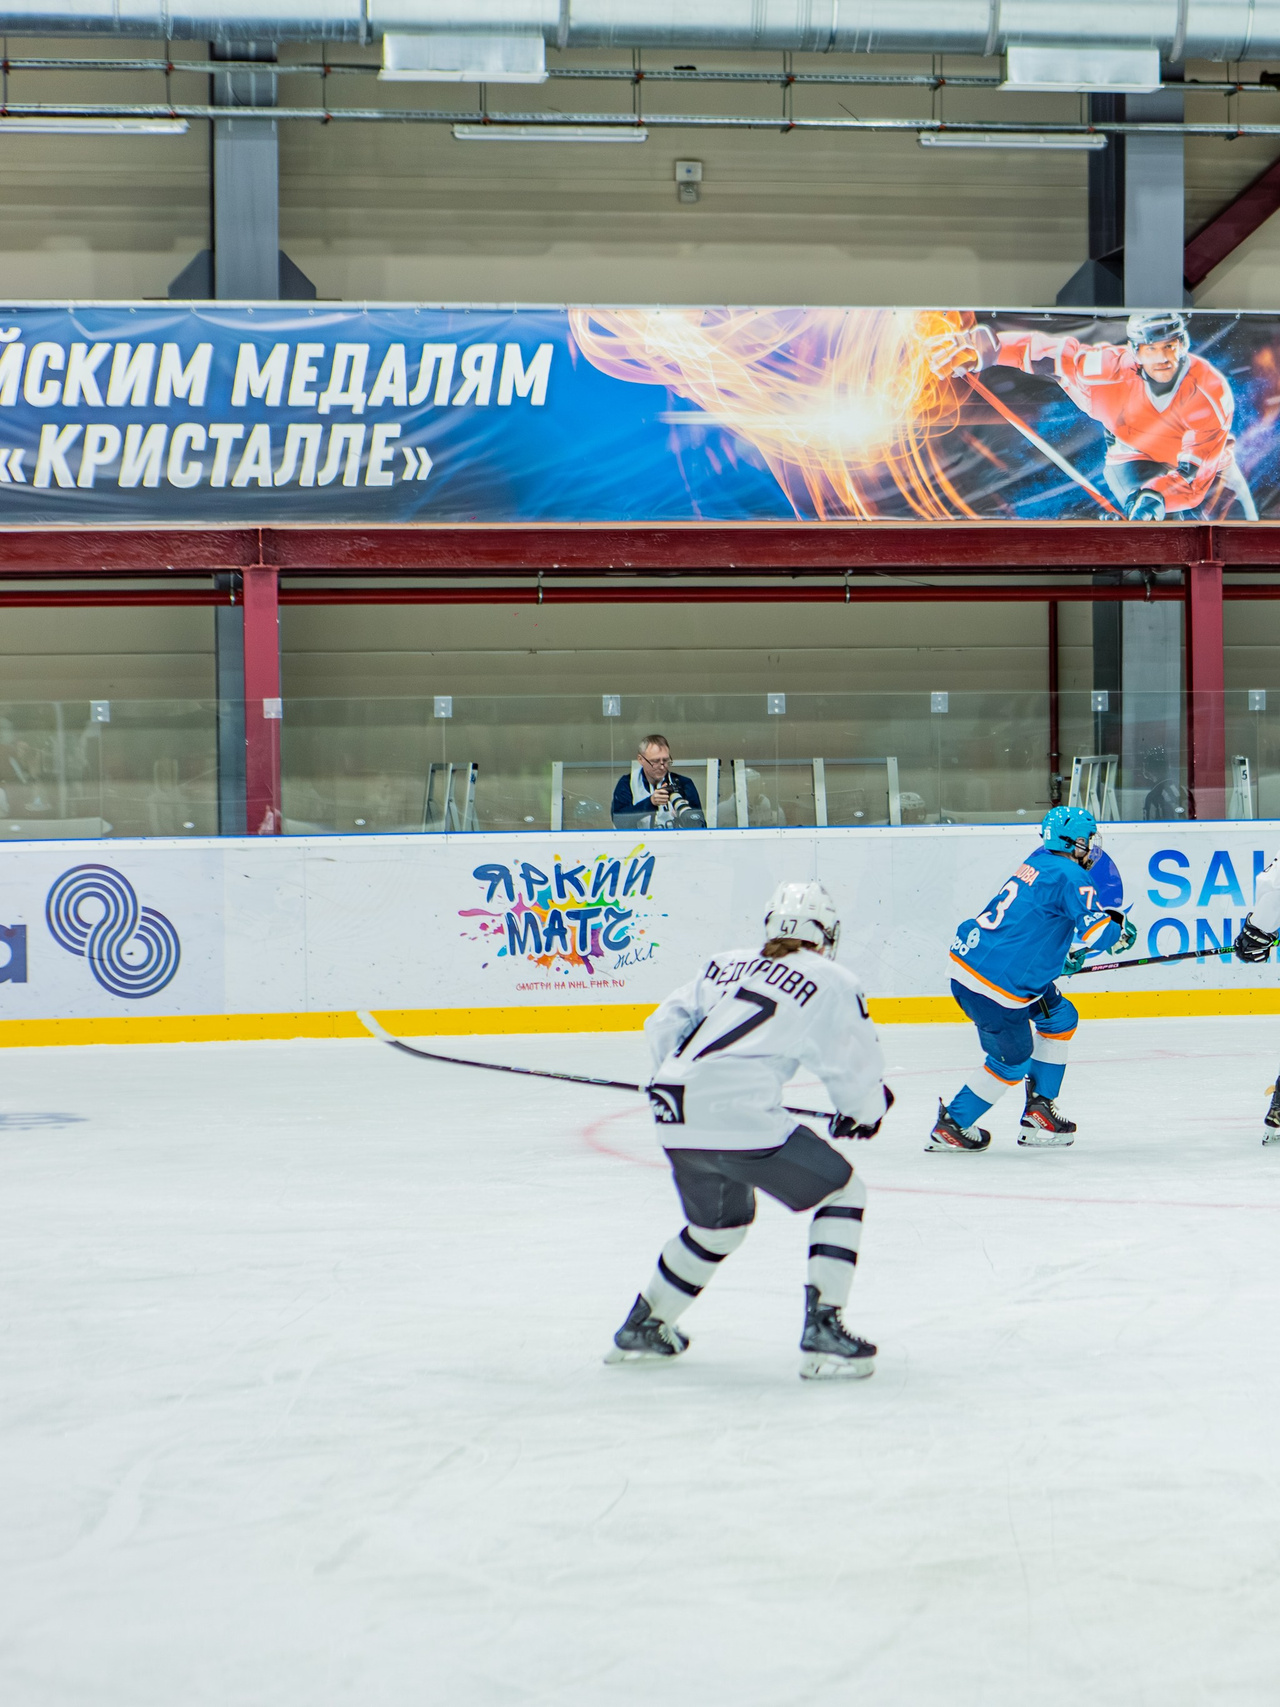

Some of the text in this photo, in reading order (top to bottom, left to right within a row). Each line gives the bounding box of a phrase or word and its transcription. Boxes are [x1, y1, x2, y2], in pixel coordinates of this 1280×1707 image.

[231, 342, 554, 415] МЕДАЛЯМ
[0, 422, 435, 489] «КРИСТАЛЛЕ»
[472, 851, 656, 903] ЯРКИЙ
[780, 918, 799, 935] 47
[516, 980, 552, 991] СМОТРИ
[554, 980, 566, 990] НА
[1032, 1112, 1049, 1128] CCM
